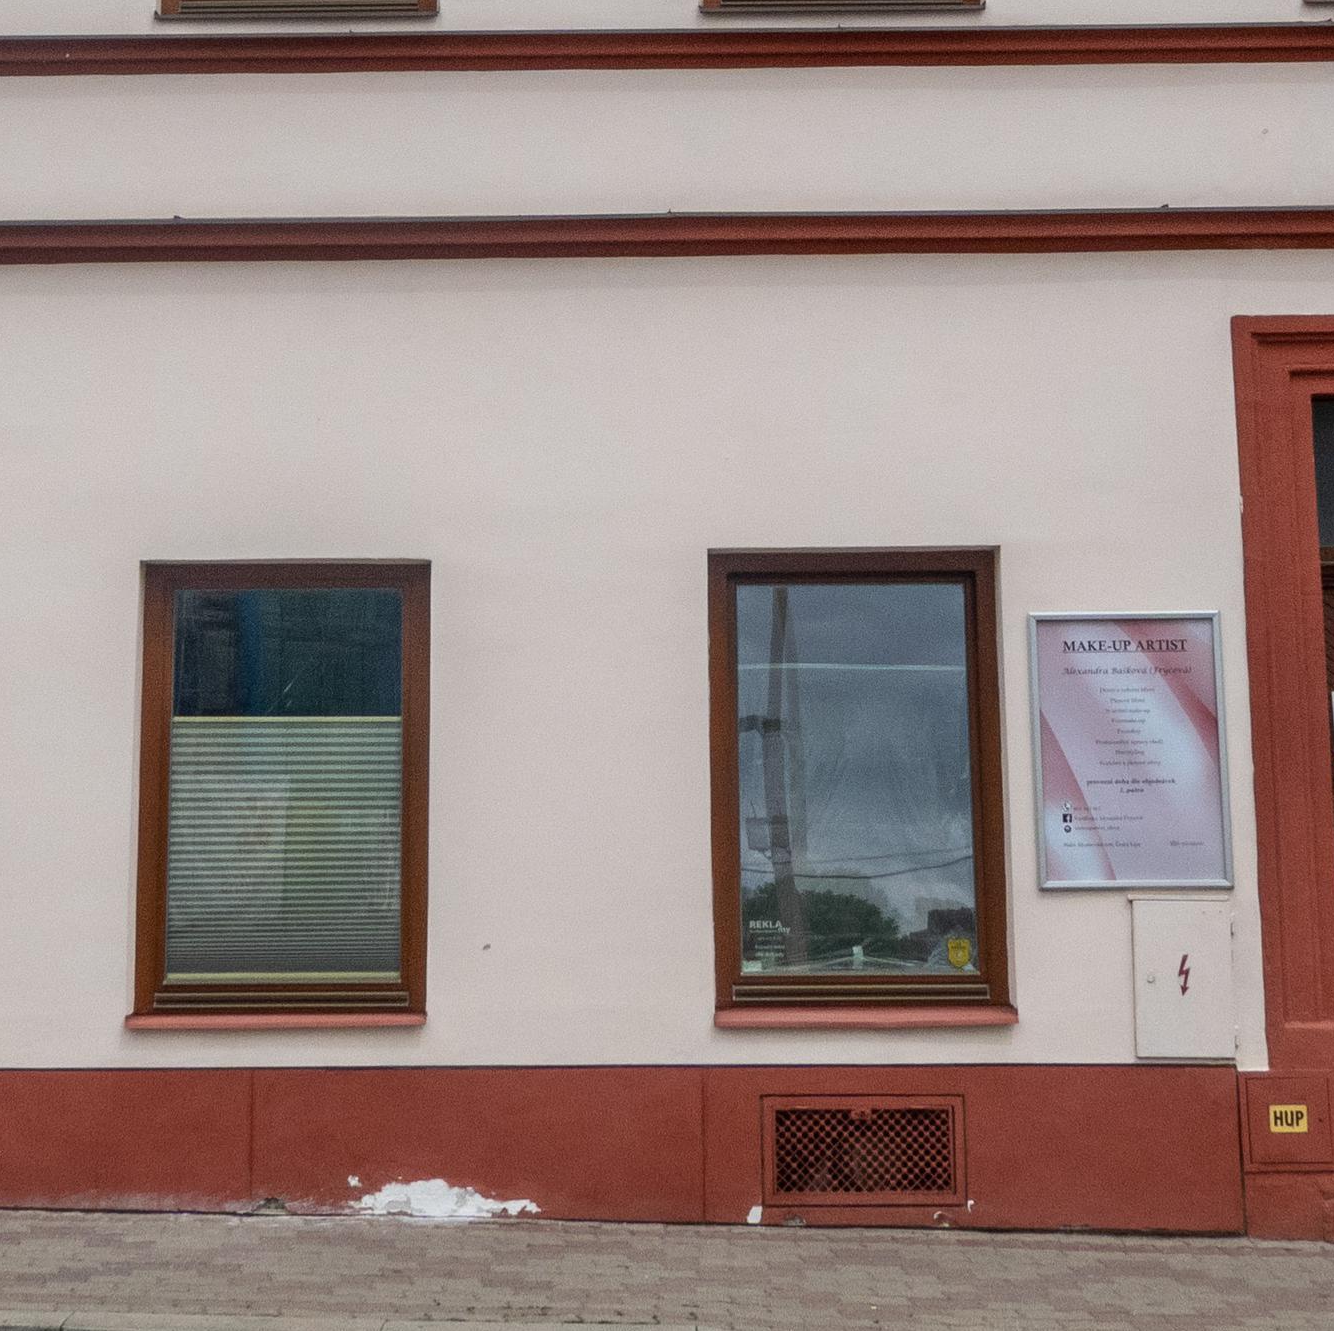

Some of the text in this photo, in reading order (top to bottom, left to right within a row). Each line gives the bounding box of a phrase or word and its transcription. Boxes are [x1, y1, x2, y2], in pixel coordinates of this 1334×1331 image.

[1063, 638, 1187, 652] MAKE-UP ARTIST
[1273, 1110, 1304, 1127] HUP
